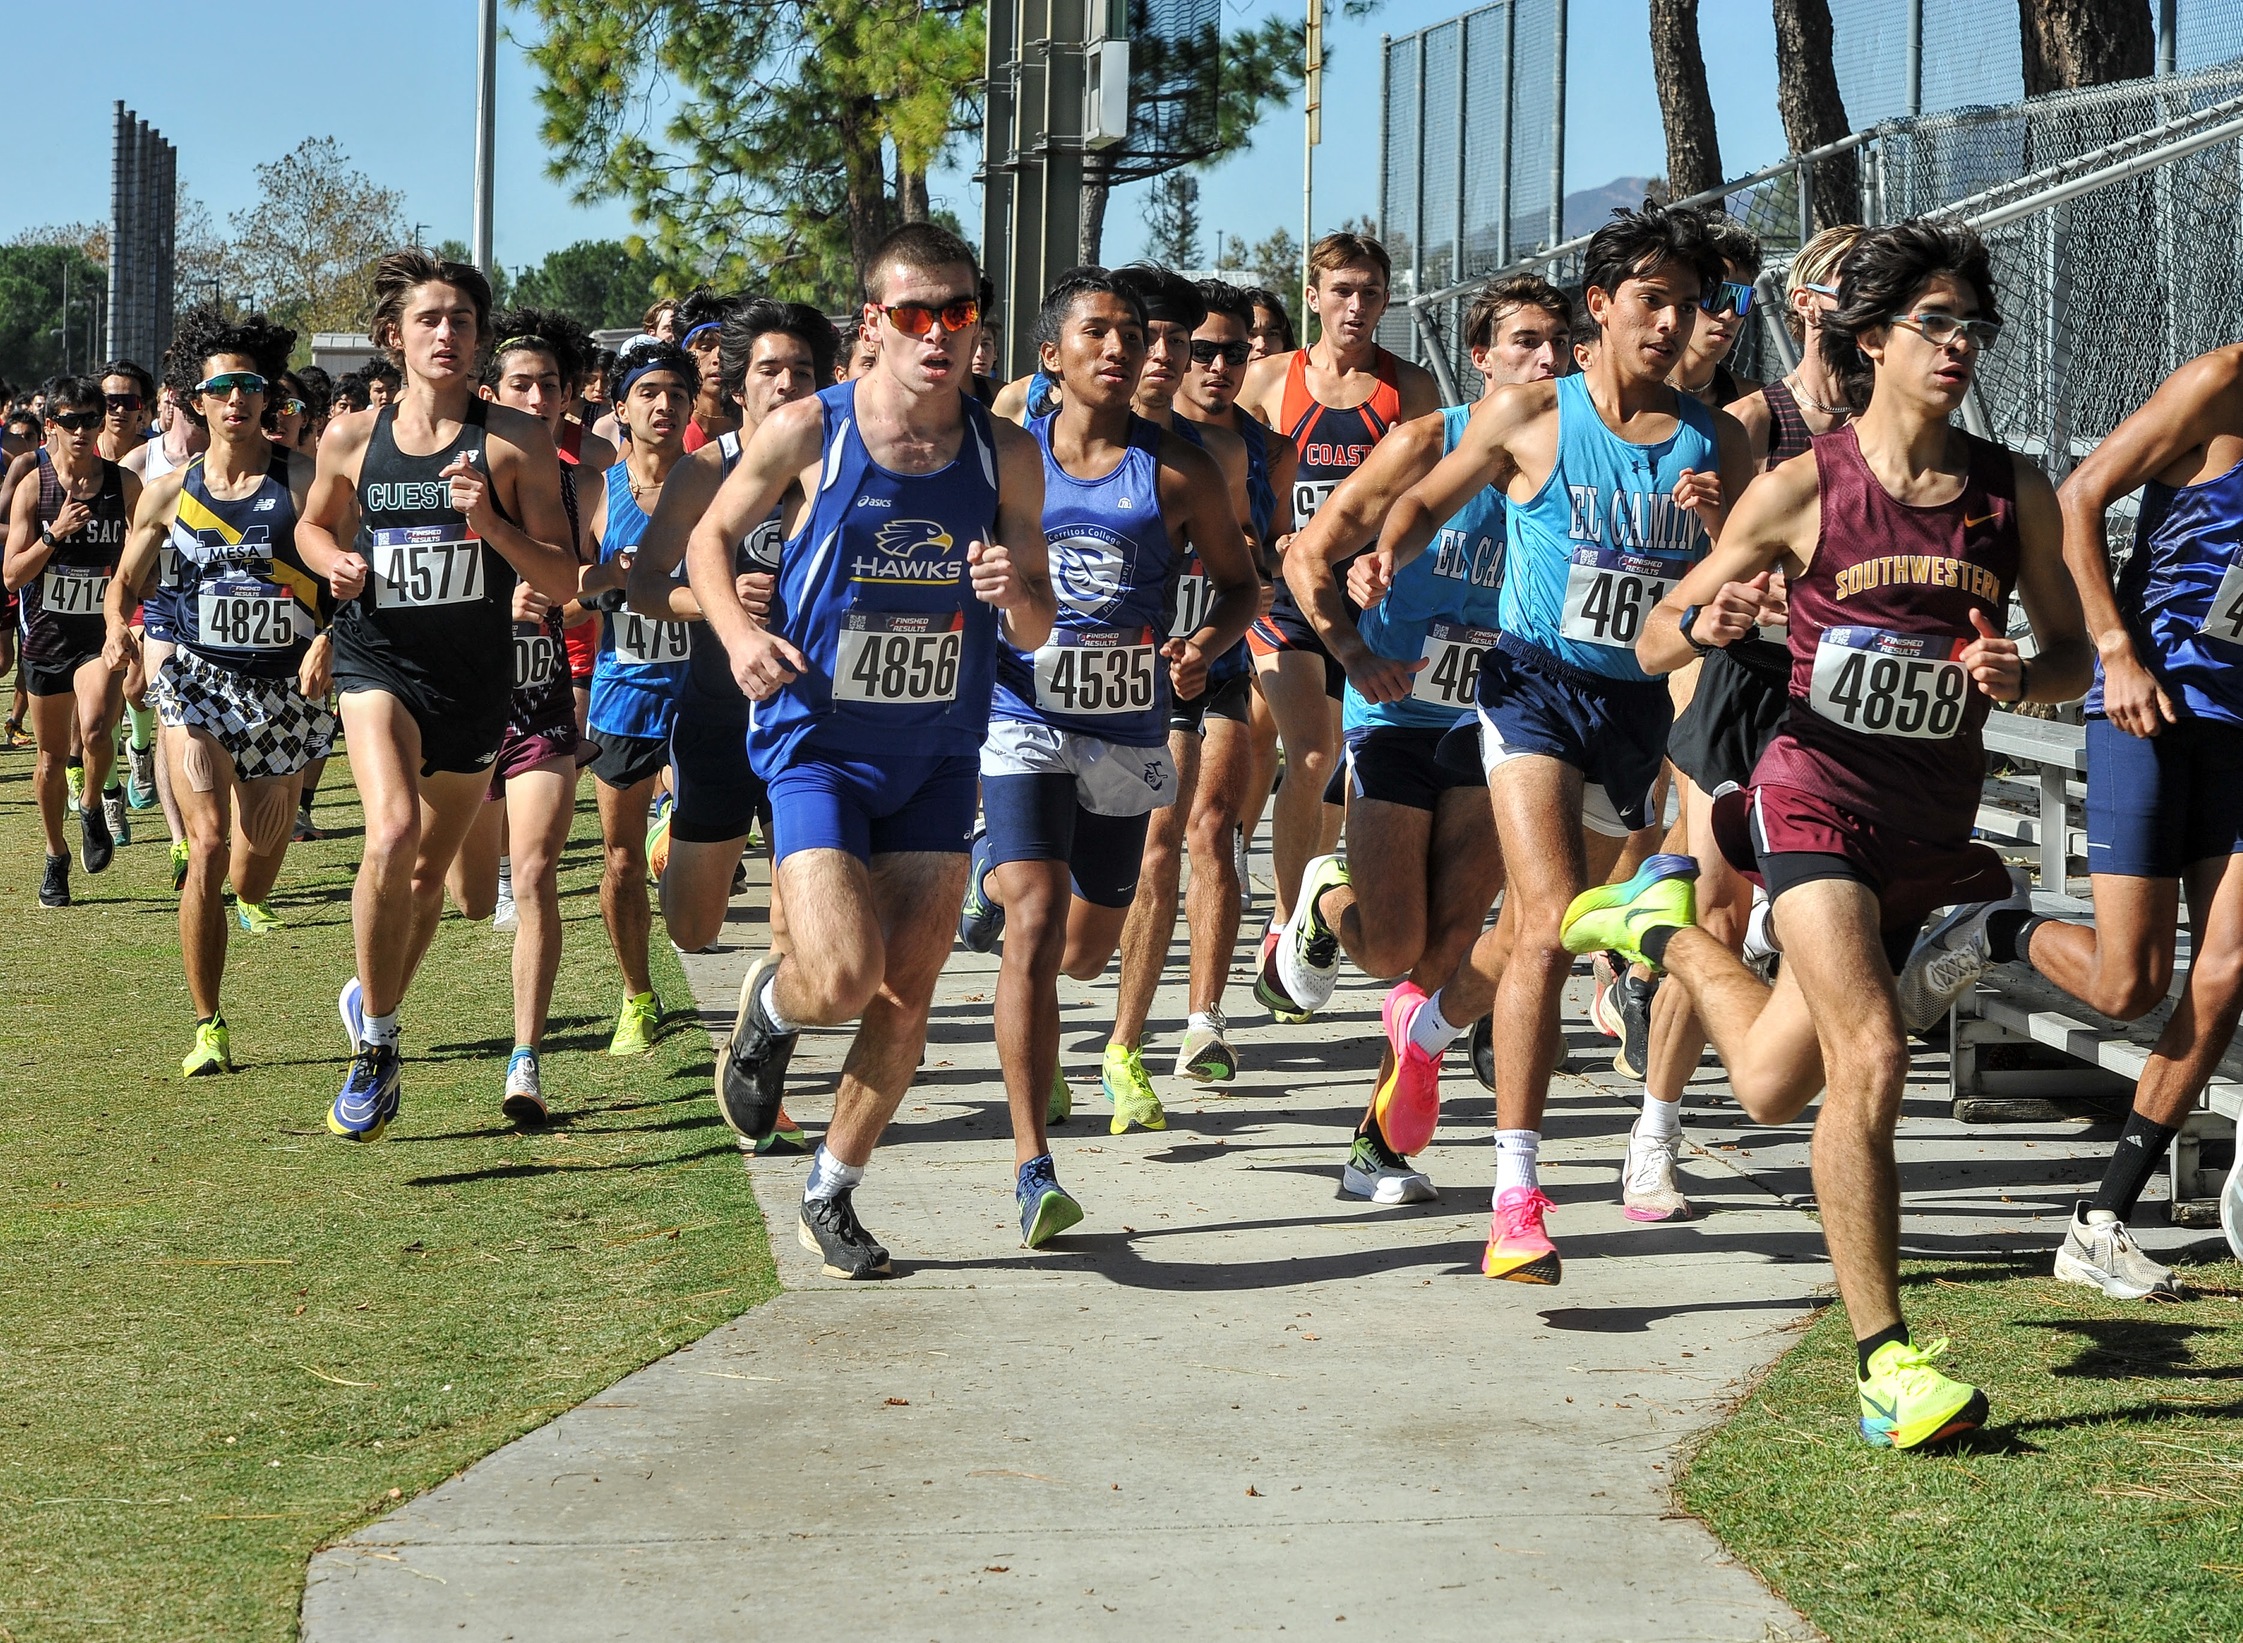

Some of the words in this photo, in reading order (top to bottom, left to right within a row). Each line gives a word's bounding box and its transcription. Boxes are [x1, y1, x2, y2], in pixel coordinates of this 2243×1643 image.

[868, 498, 892, 507] asics
[1568, 484, 1602, 542] EL
[86, 519, 121, 543] SAC
[1048, 528, 1085, 542] Cerritos
[1088, 528, 1121, 546] College
[209, 545, 261, 562] MESA
[1432, 528, 1468, 580] EL
[1627, 556, 1663, 568] FINISHED
[387, 542, 479, 602] 4577
[850, 555, 962, 579] HAWKS
[1624, 565, 1660, 576] RESULTS
[1834, 555, 2000, 608] SOUTHWESTERN
[210, 598, 291, 645] 4825
[892, 625, 927, 633] RESULTS
[894, 617, 929, 625] FINISHED
[1084, 639, 1118, 647] RESULTS
[1086, 632, 1120, 640] FINISHED
[1883, 635, 1924, 647] FINISHED
[1880, 645, 1921, 657] RESULTS
[851, 634, 959, 699] 4856
[1431, 643, 1482, 705] 46
[1050, 647, 1152, 709] 4535
[1829, 653, 1965, 735] 4858
